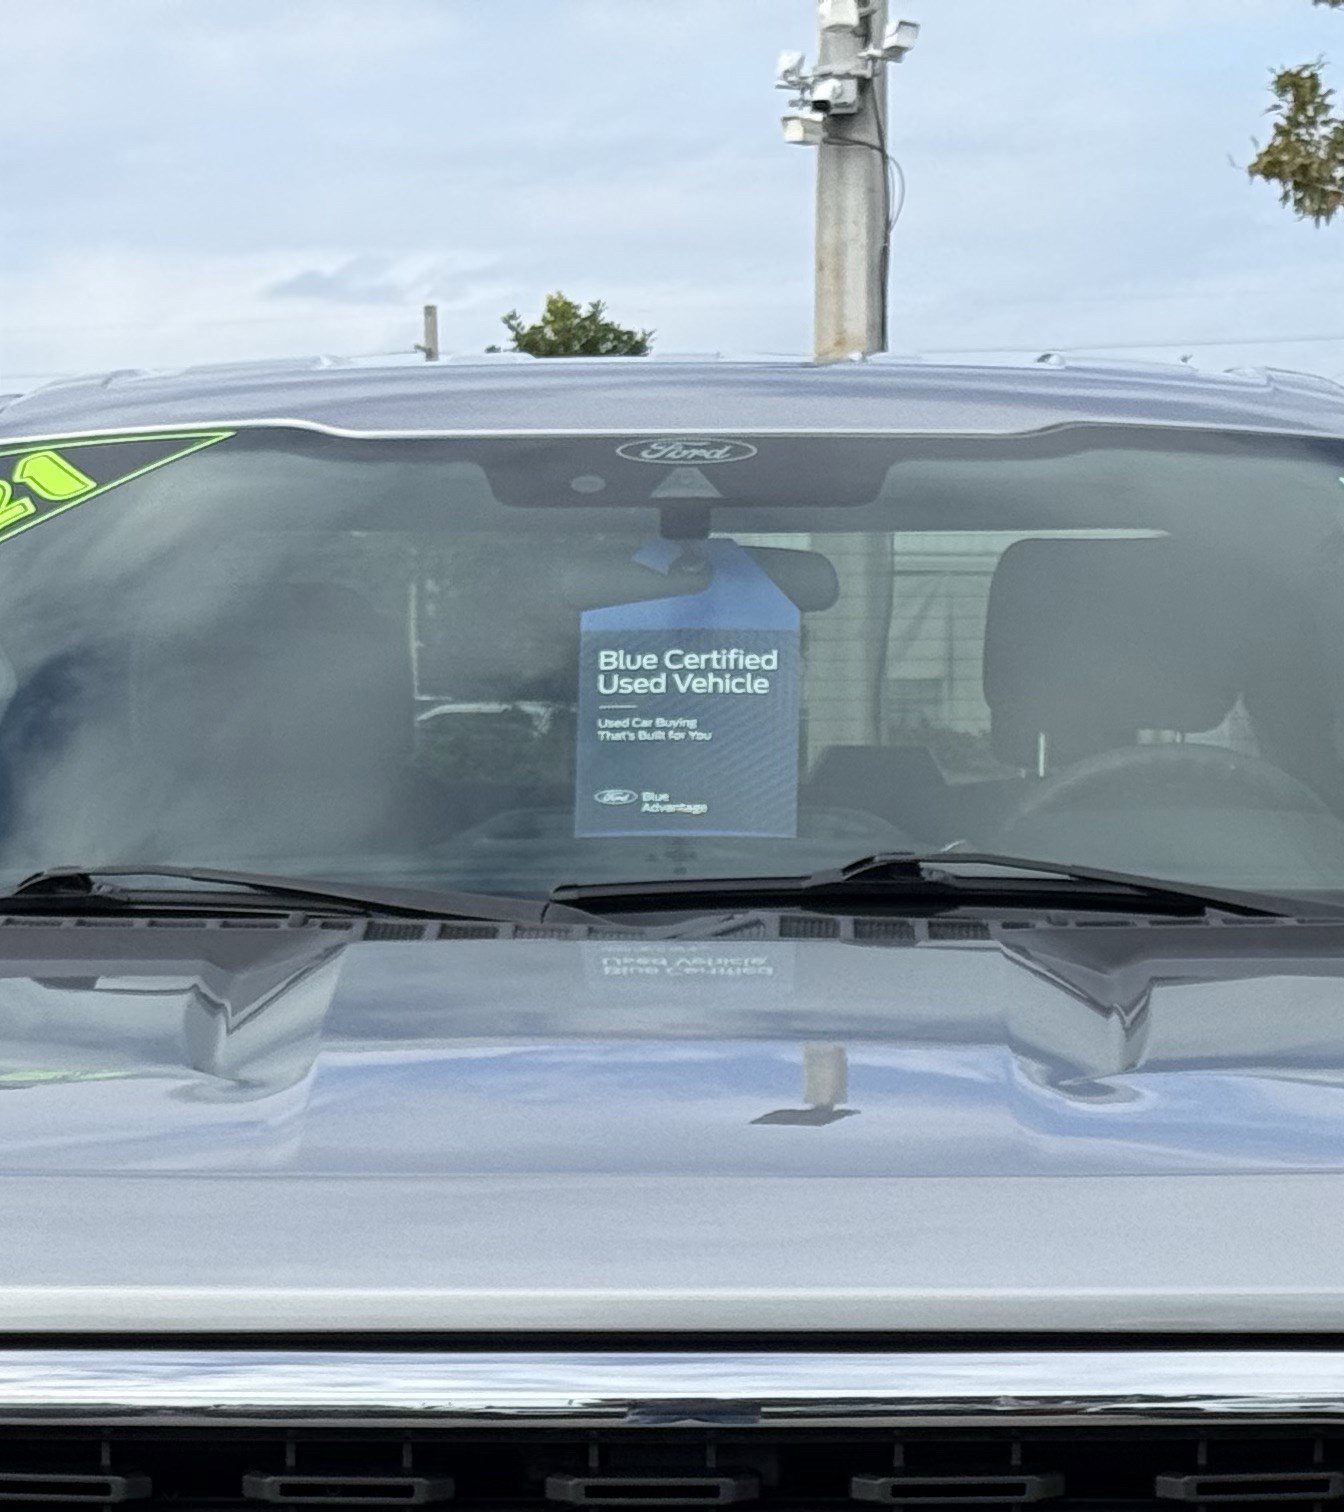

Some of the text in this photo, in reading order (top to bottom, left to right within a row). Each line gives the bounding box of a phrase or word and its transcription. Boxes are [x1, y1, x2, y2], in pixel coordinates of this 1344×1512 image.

[640, 441, 734, 460] Ford
[598, 648, 779, 671] Blue Certified
[597, 672, 771, 695] Used Vehicle
[598, 717, 698, 730] Used Car Buying
[597, 730, 713, 741] That's Built for You
[641, 791, 670, 802] Blue
